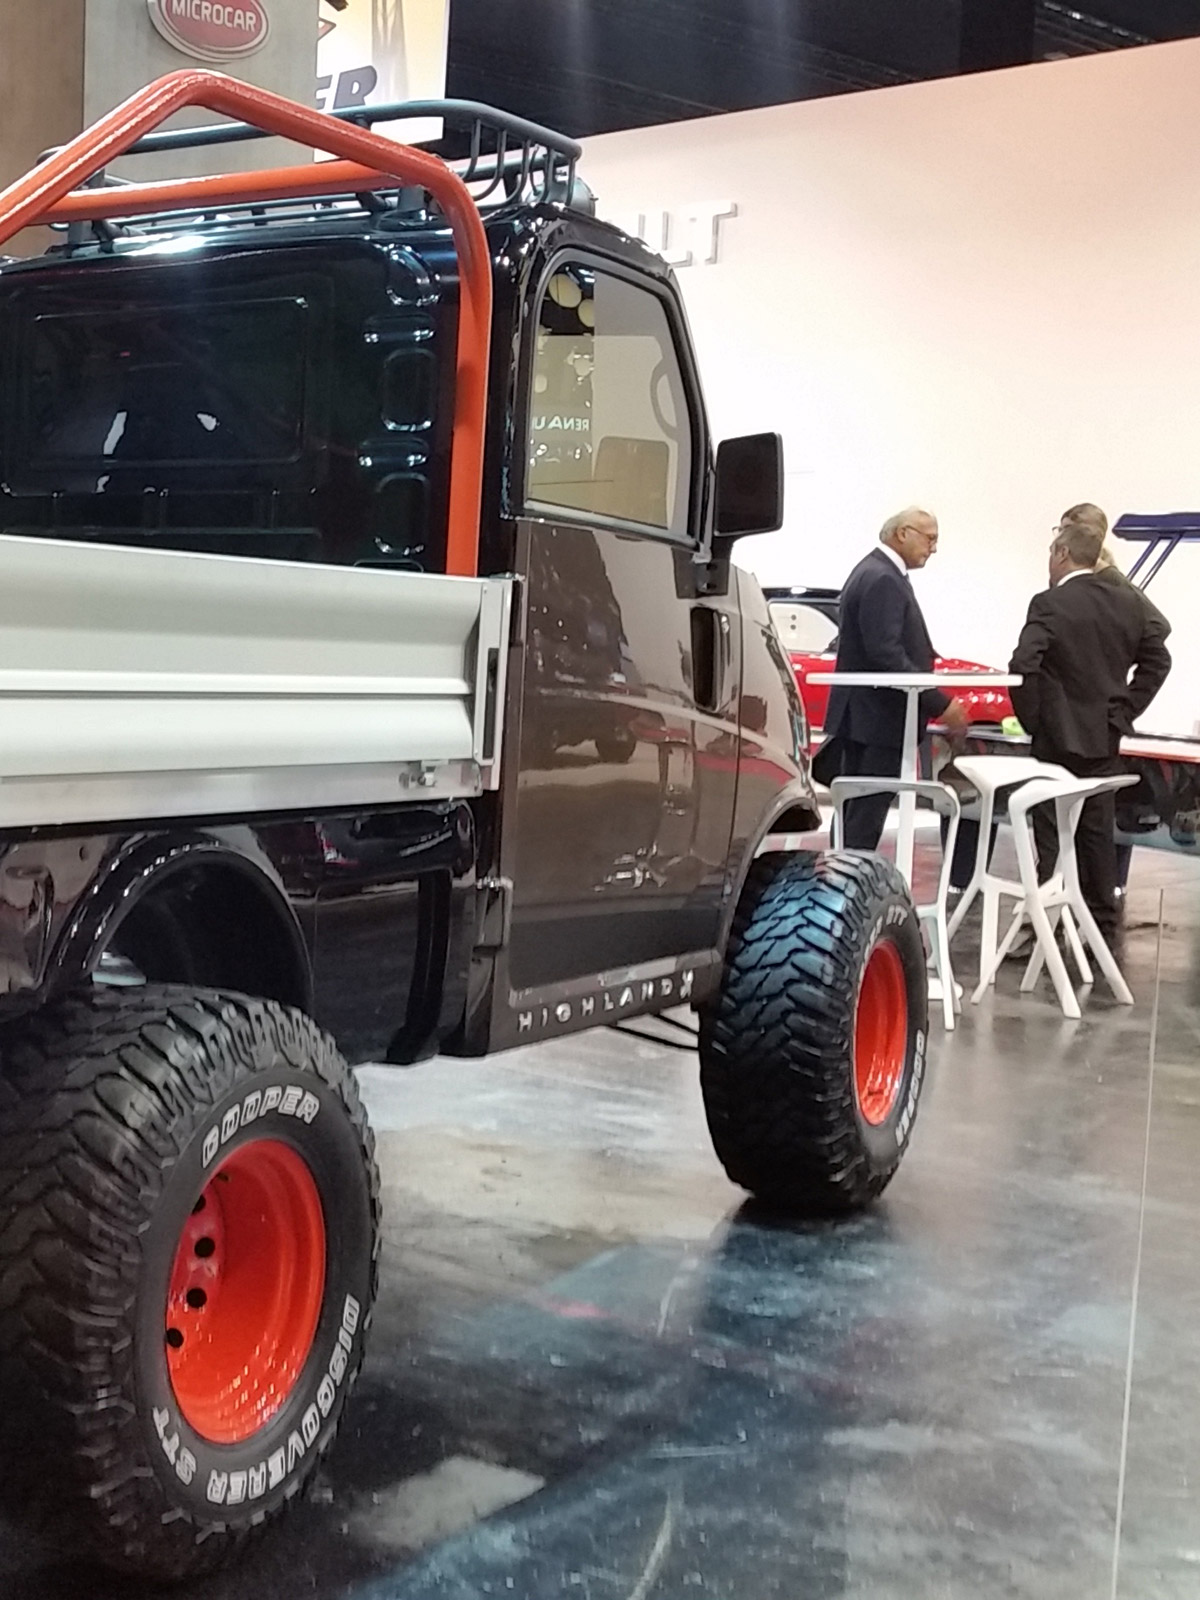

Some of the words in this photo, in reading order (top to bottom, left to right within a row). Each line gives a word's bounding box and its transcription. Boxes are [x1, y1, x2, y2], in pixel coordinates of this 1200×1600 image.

[172, 0, 257, 33] MICROCAR
[202, 1084, 320, 1168] COOPER
[206, 1294, 360, 1506] DISCOVERER
[152, 1406, 197, 1486] STT
